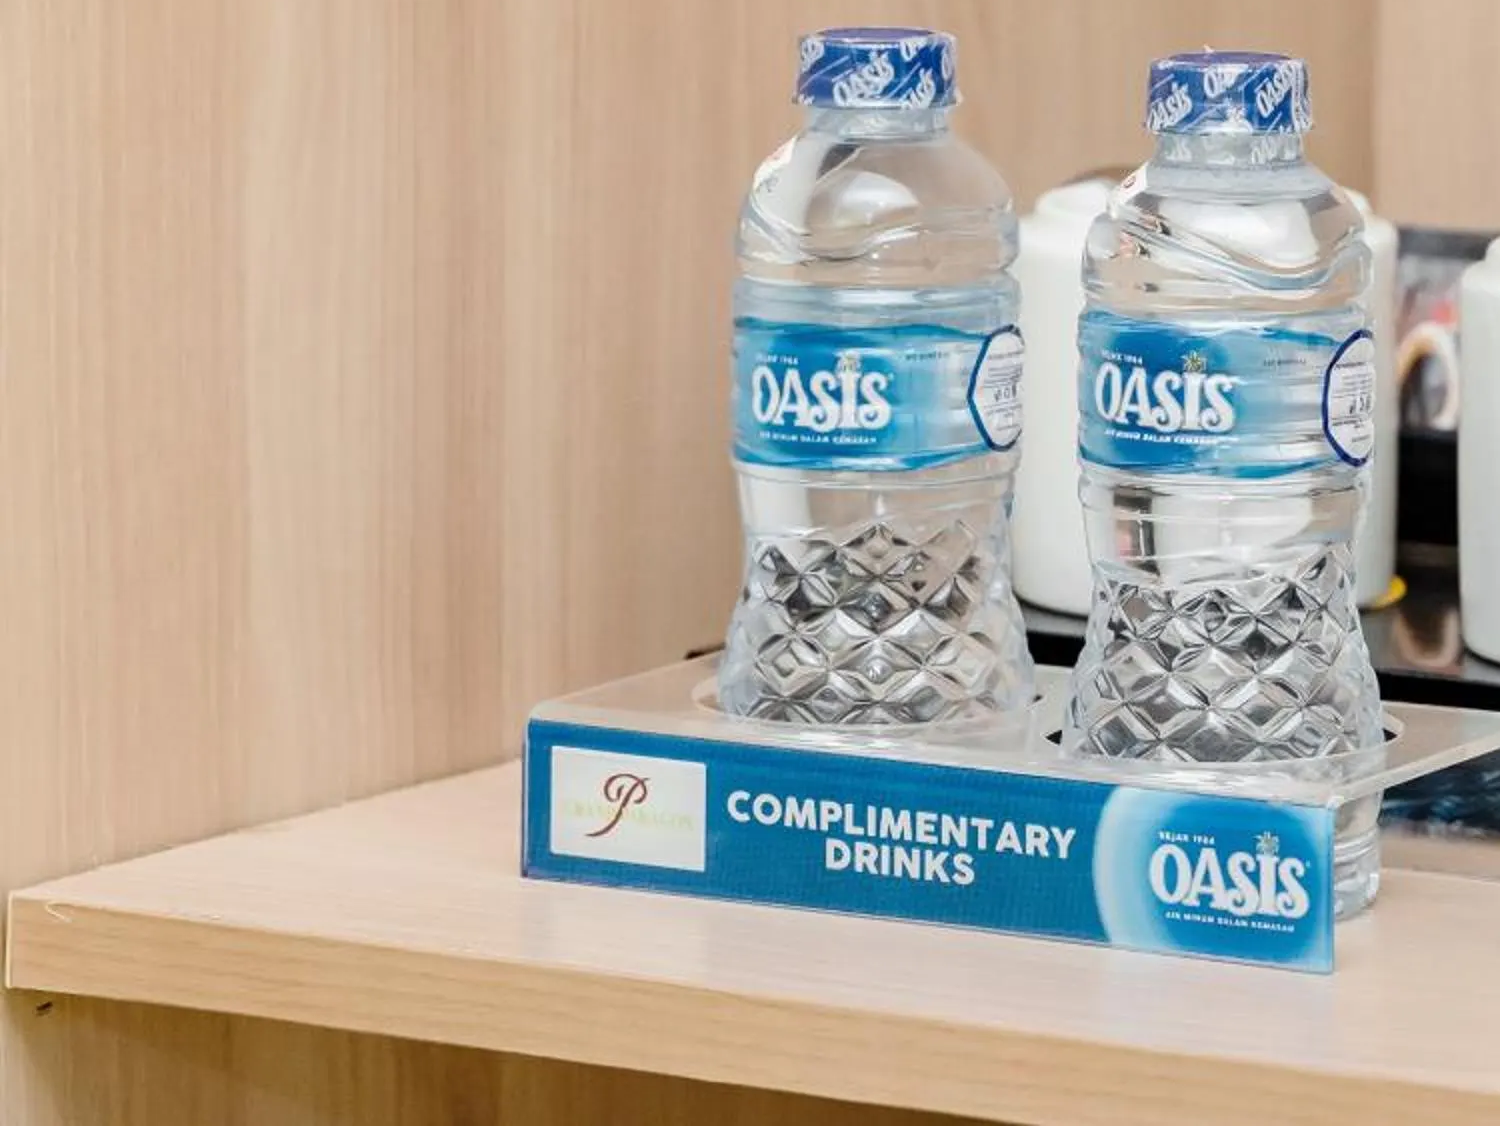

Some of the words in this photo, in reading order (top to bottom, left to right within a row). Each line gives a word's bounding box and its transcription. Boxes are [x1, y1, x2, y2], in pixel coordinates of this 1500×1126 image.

[752, 366, 892, 433] OASIS
[1095, 362, 1237, 433] OASIS
[727, 790, 1077, 859] COMPLIMENTARY
[825, 838, 975, 885] DRINKS
[1150, 843, 1309, 919] OASIS
